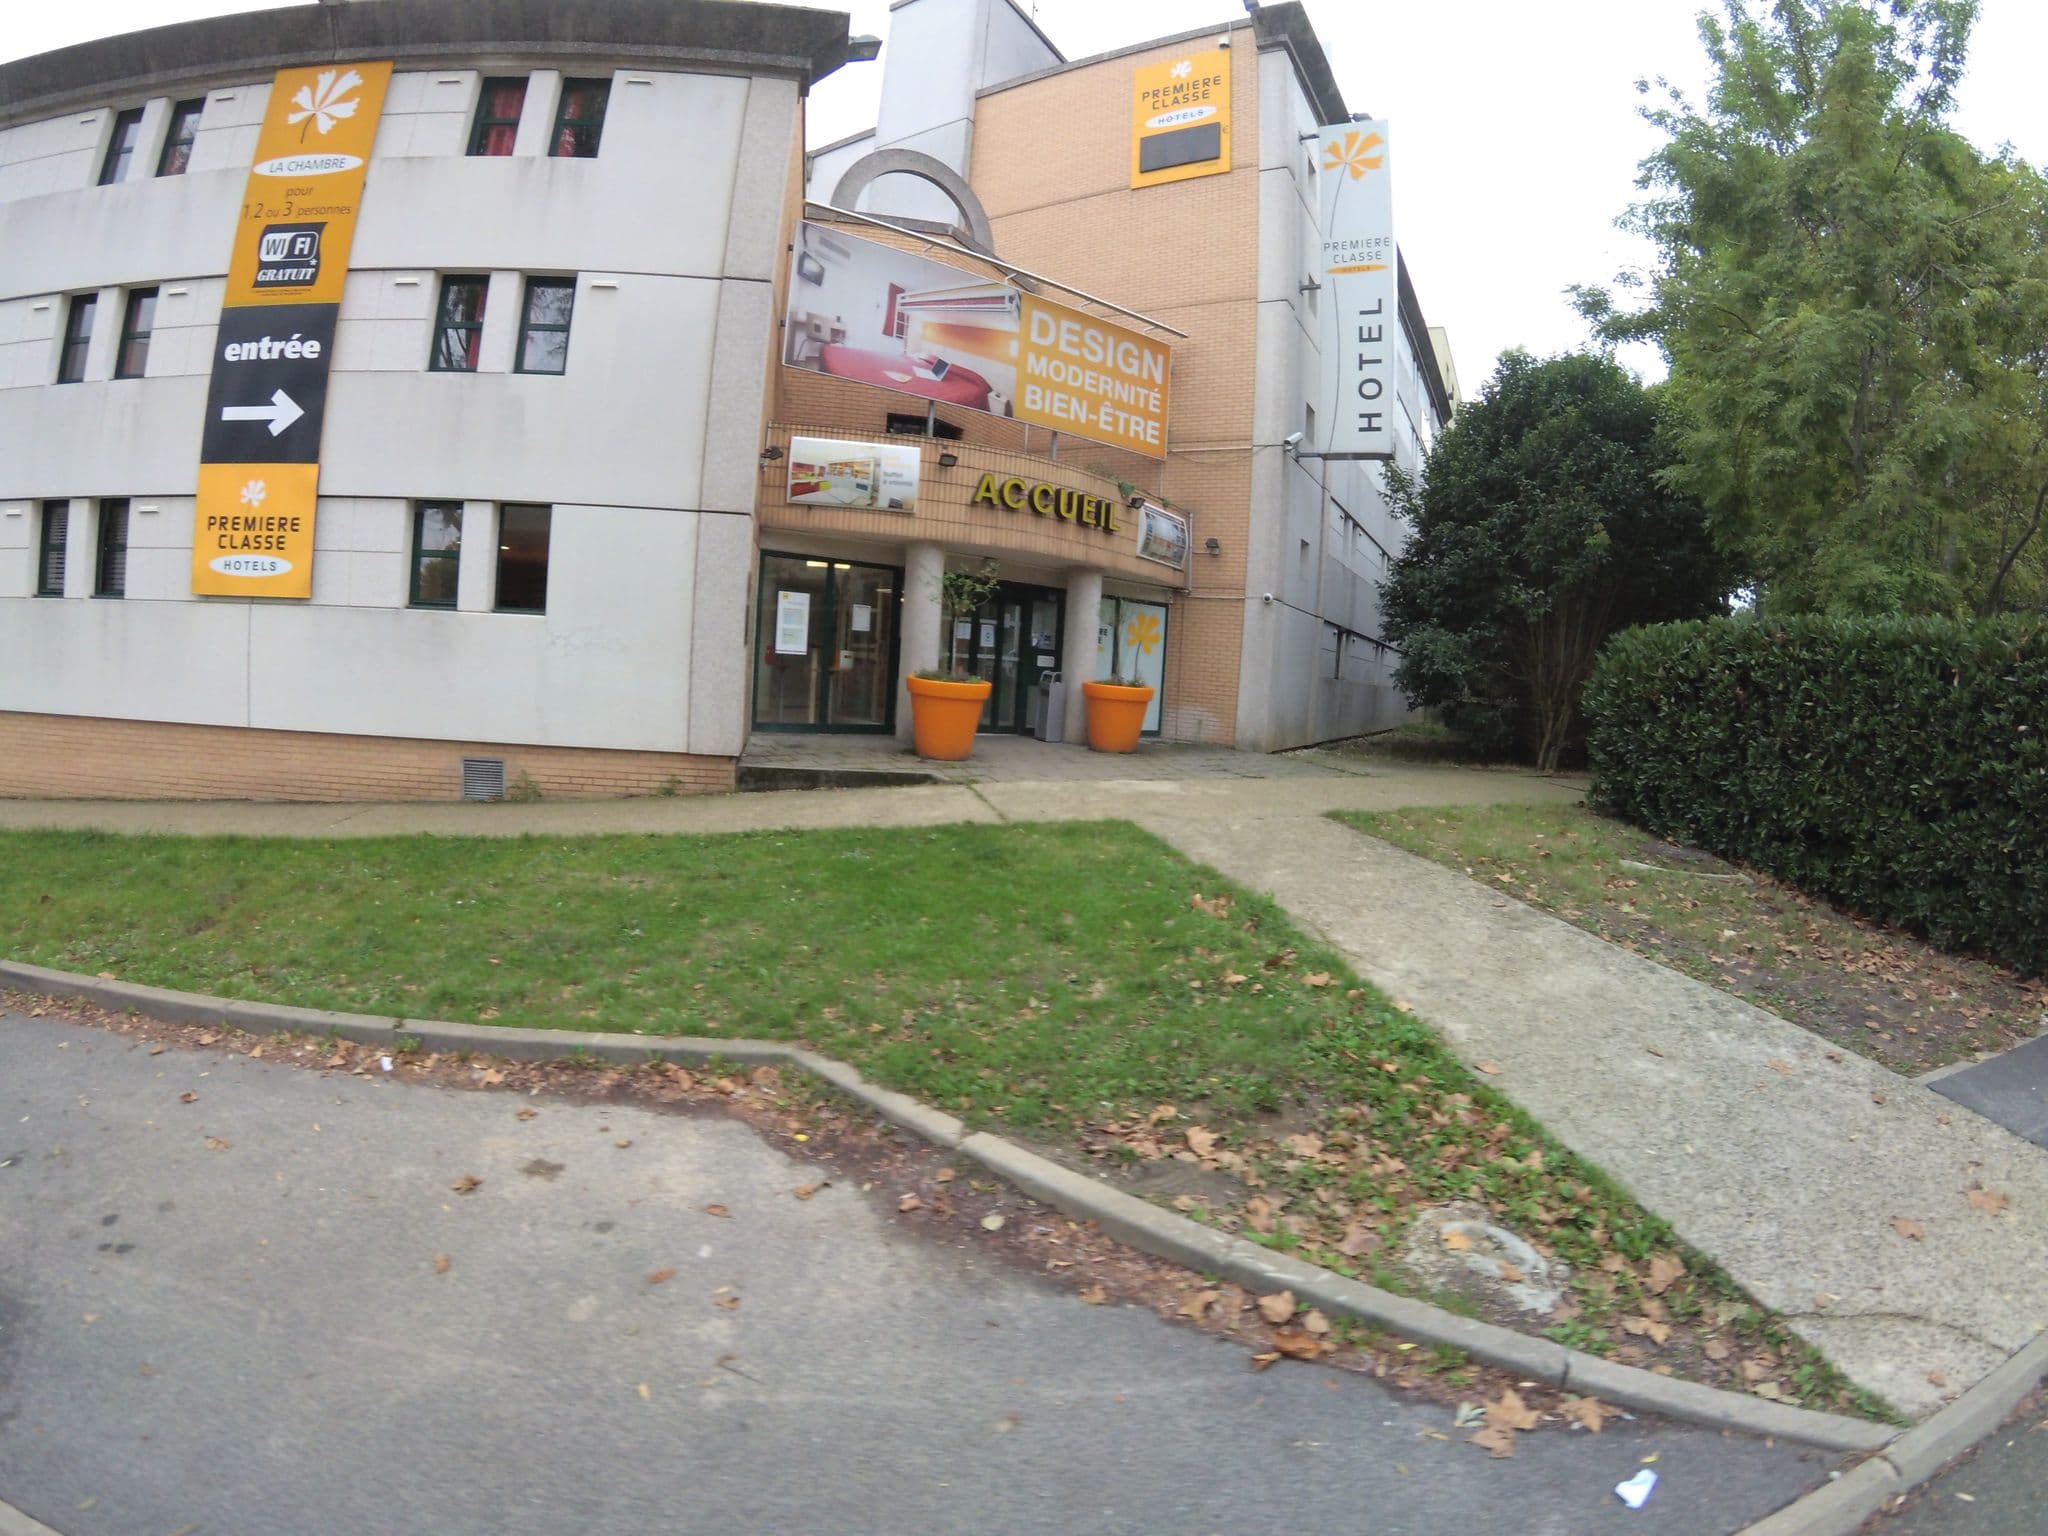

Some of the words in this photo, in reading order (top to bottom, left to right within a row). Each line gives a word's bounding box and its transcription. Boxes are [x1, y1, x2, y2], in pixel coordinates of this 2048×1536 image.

[1142, 75, 1221, 102] PREMIERE
[1152, 90, 1210, 110] CLASSE
[1158, 109, 1204, 125] HOTELS
[269, 162, 284, 174] LA
[287, 157, 346, 172] CHAMBRE
[285, 187, 314, 199] pour
[266, 208, 280, 217] ou
[283, 201, 294, 216] 3
[296, 205, 353, 218] personnes
[1323, 236, 1390, 252] PREMIERE
[1333, 250, 1382, 264] CLASSE
[257, 267, 316, 282] GRATUIT
[224, 333, 321, 362] entrée
[1029, 309, 1164, 385] DESIGN
[1358, 298, 1383, 433] HOTEL
[1026, 351, 1161, 413] MODERNITÉ
[1024, 384, 1161, 445] BIEN-ÊTRE
[975, 472, 1120, 533] ACCUEIL
[207, 516, 301, 533] PREMIERE
[217, 534, 286, 551] CLASSE
[223, 559, 277, 572] HOTELS
